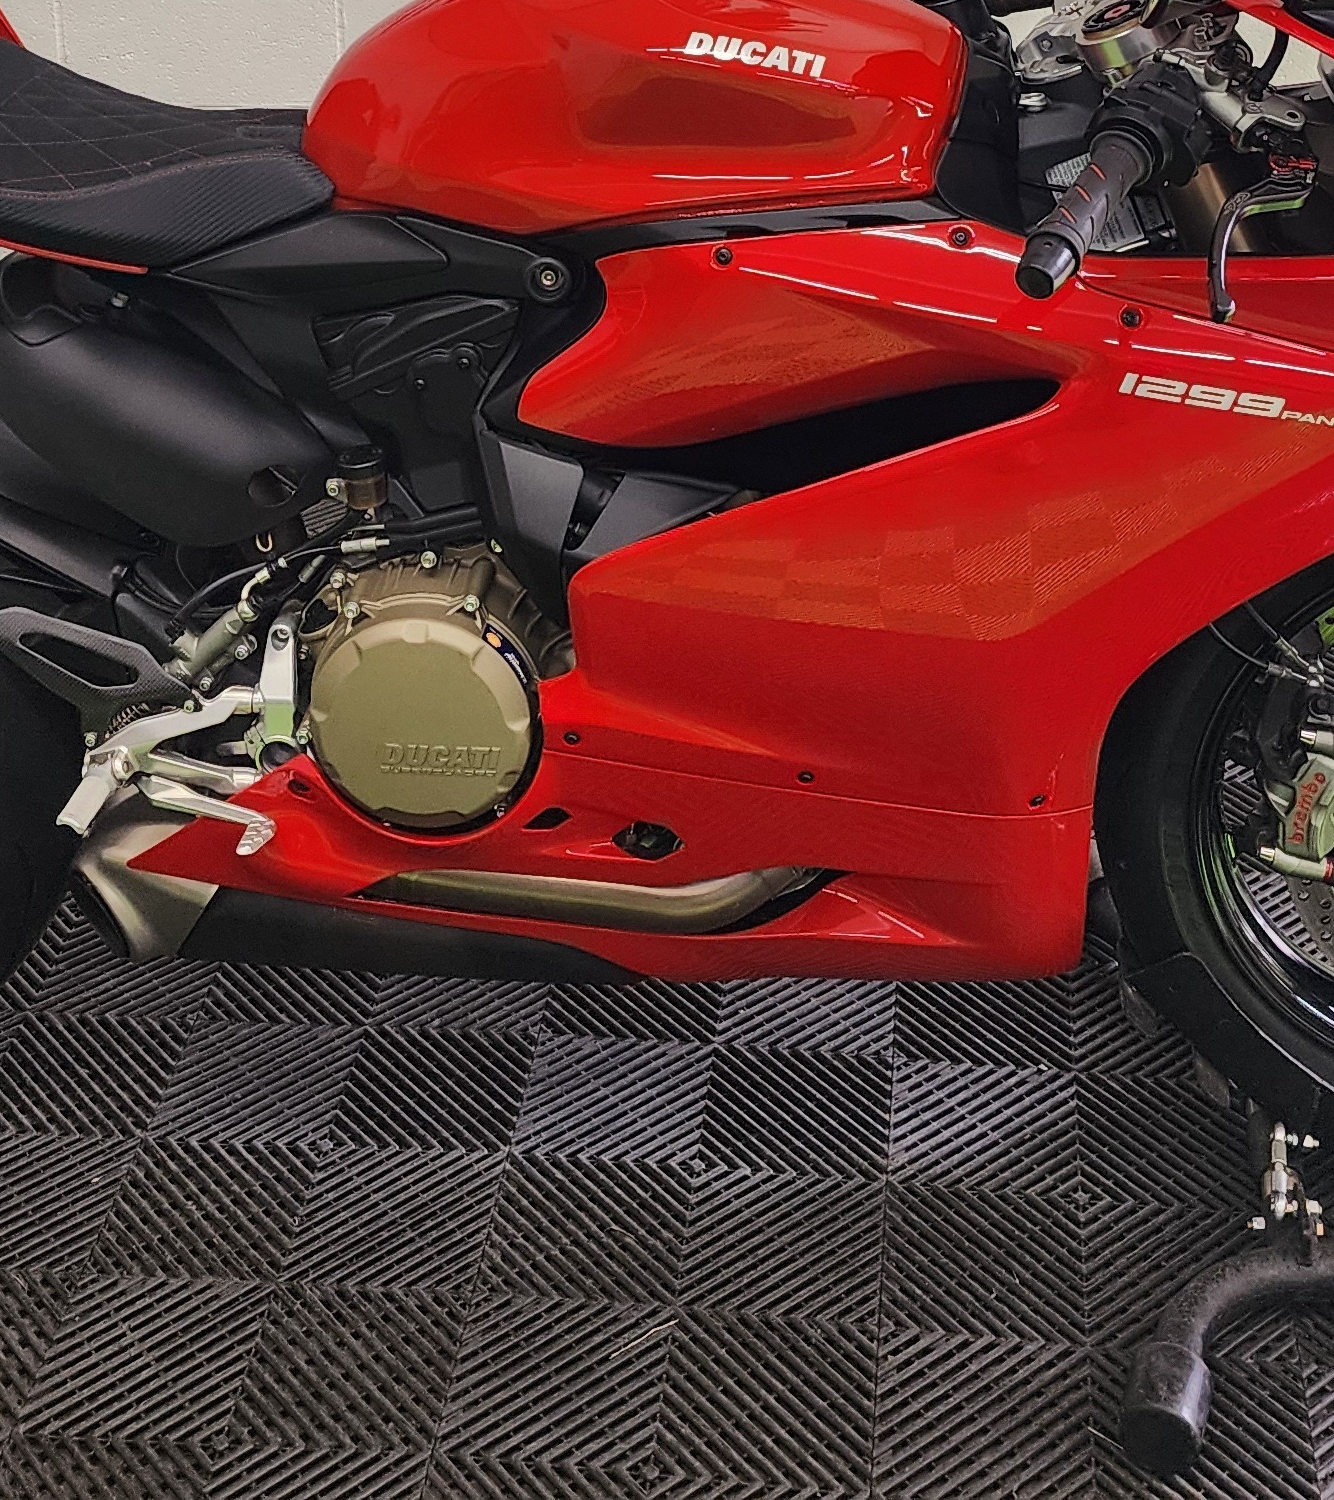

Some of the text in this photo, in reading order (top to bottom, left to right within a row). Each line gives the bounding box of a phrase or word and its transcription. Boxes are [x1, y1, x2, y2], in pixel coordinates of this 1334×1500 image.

[682, 31, 827, 78] DUCATI
[1119, 372, 1286, 418] 1299
[382, 742, 501, 769] DUCATI
[1286, 772, 1326, 845] brembo
